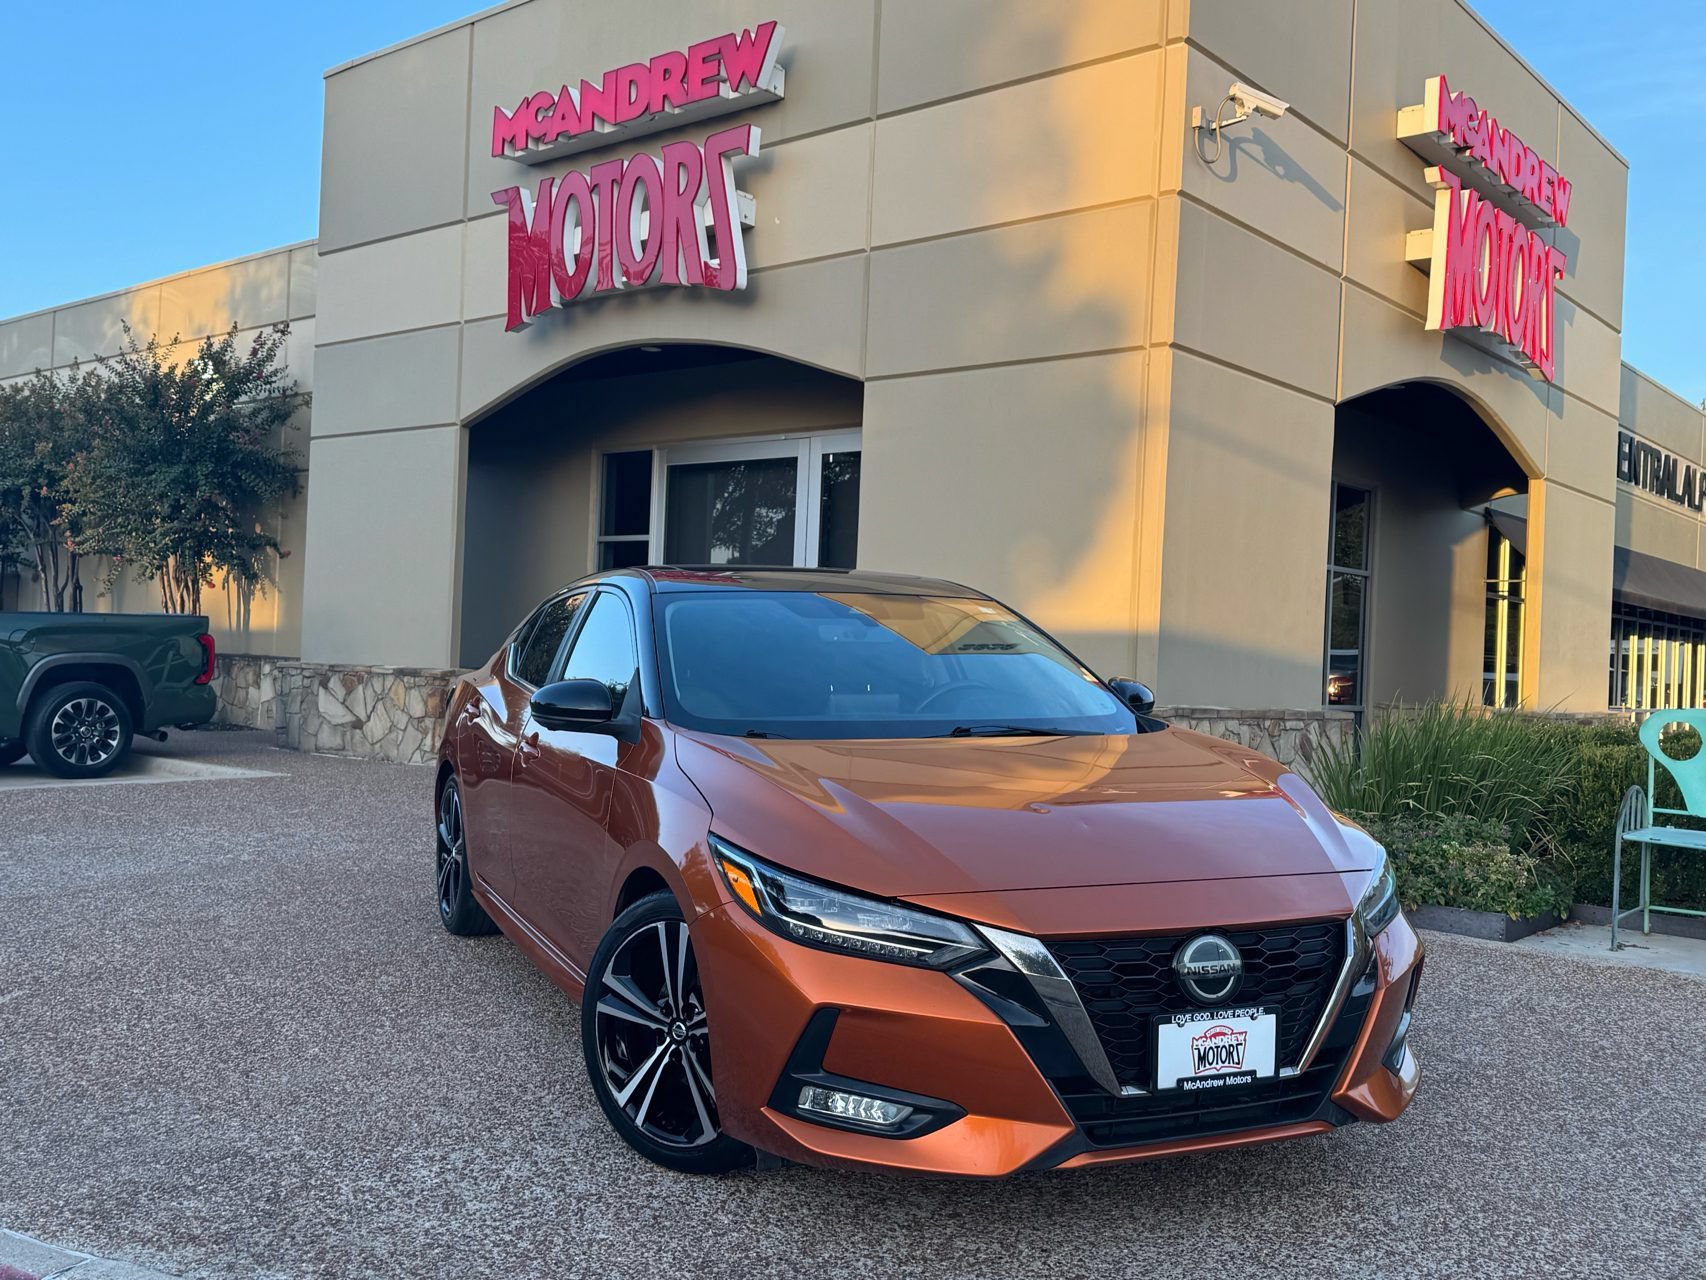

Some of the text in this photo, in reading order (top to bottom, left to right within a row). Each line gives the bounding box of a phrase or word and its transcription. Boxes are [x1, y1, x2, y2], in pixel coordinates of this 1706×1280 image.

[490, 123, 754, 332] MOTORS
[1437, 165, 1568, 383] MOTORS
[1186, 963, 1236, 976] NISSAN
[1171, 1013, 1192, 1024] LOVE
[1214, 1009, 1234, 1020] LOVE
[1194, 1043, 1243, 1071] MOTORS
[1183, 1074, 1252, 1090] McAndrew Motors
